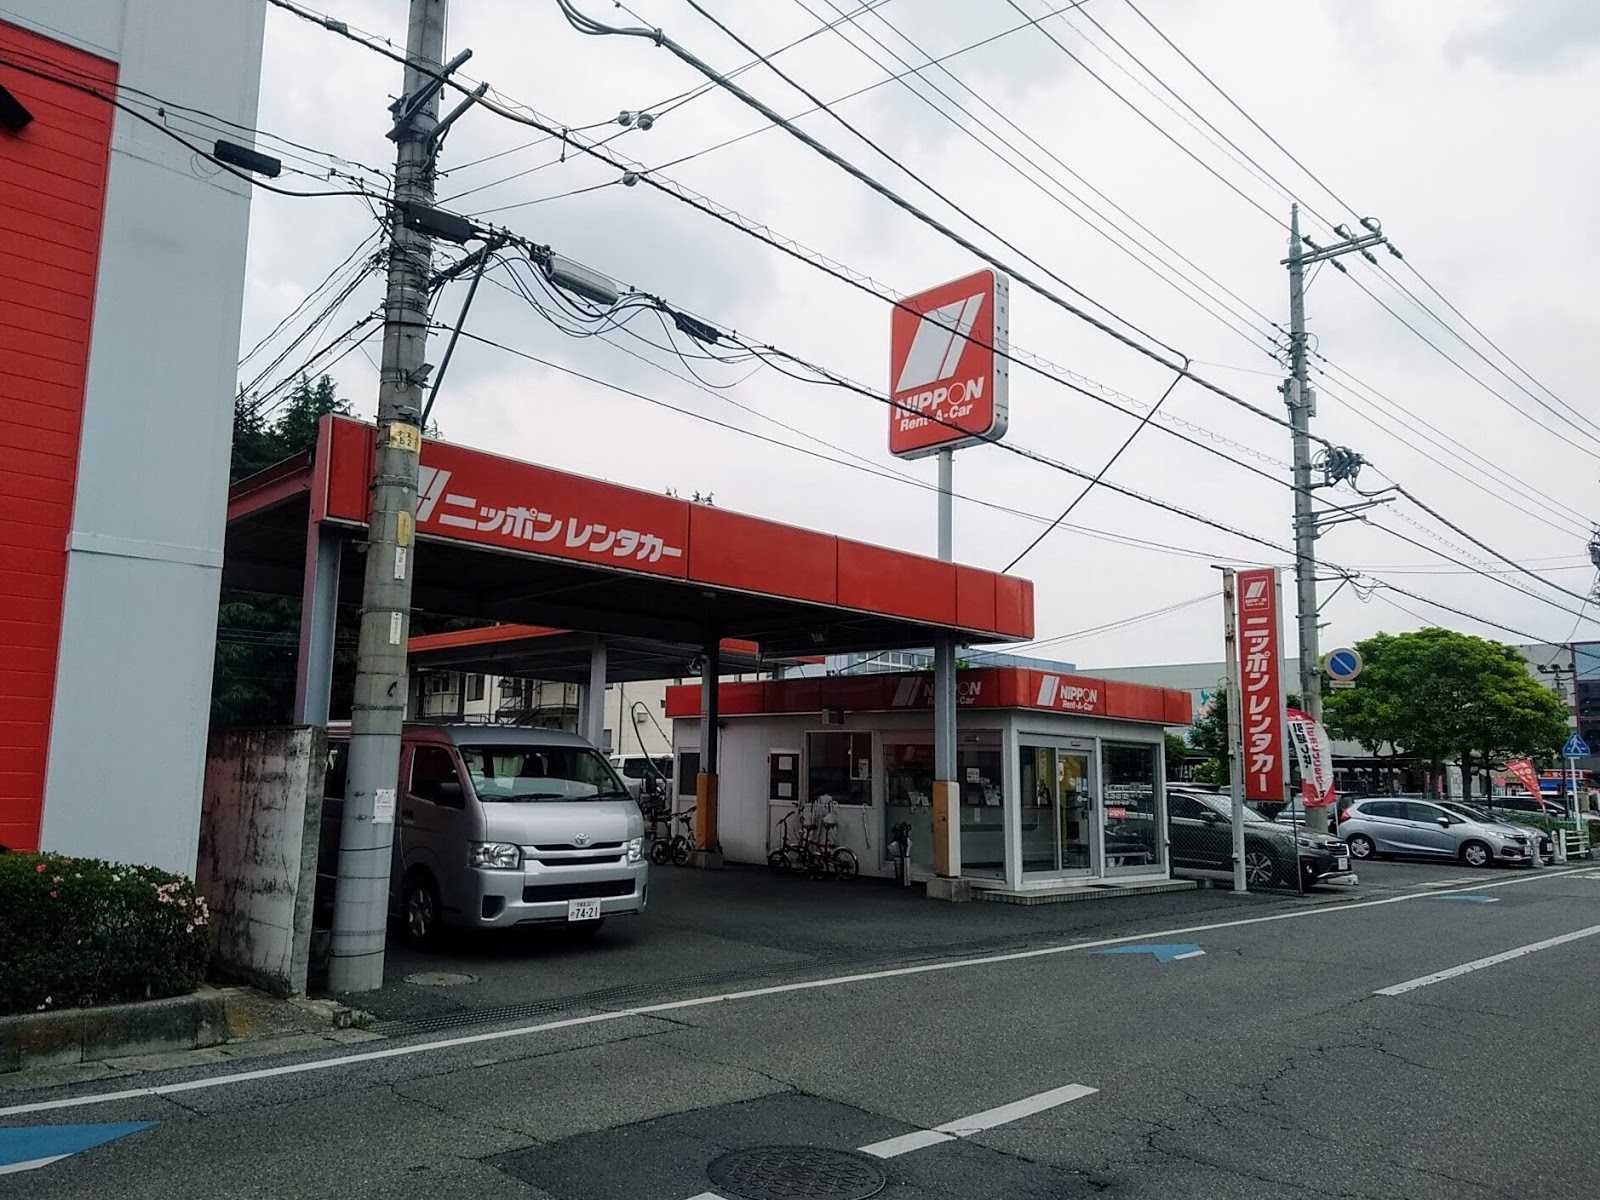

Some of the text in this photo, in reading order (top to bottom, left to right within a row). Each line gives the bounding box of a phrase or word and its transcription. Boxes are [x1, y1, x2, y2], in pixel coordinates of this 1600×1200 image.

[895, 377, 984, 420] NIPPON
[1060, 685, 1098, 703] NIPPON
[1244, 616, 1274, 792] ニッポンレンタカー
